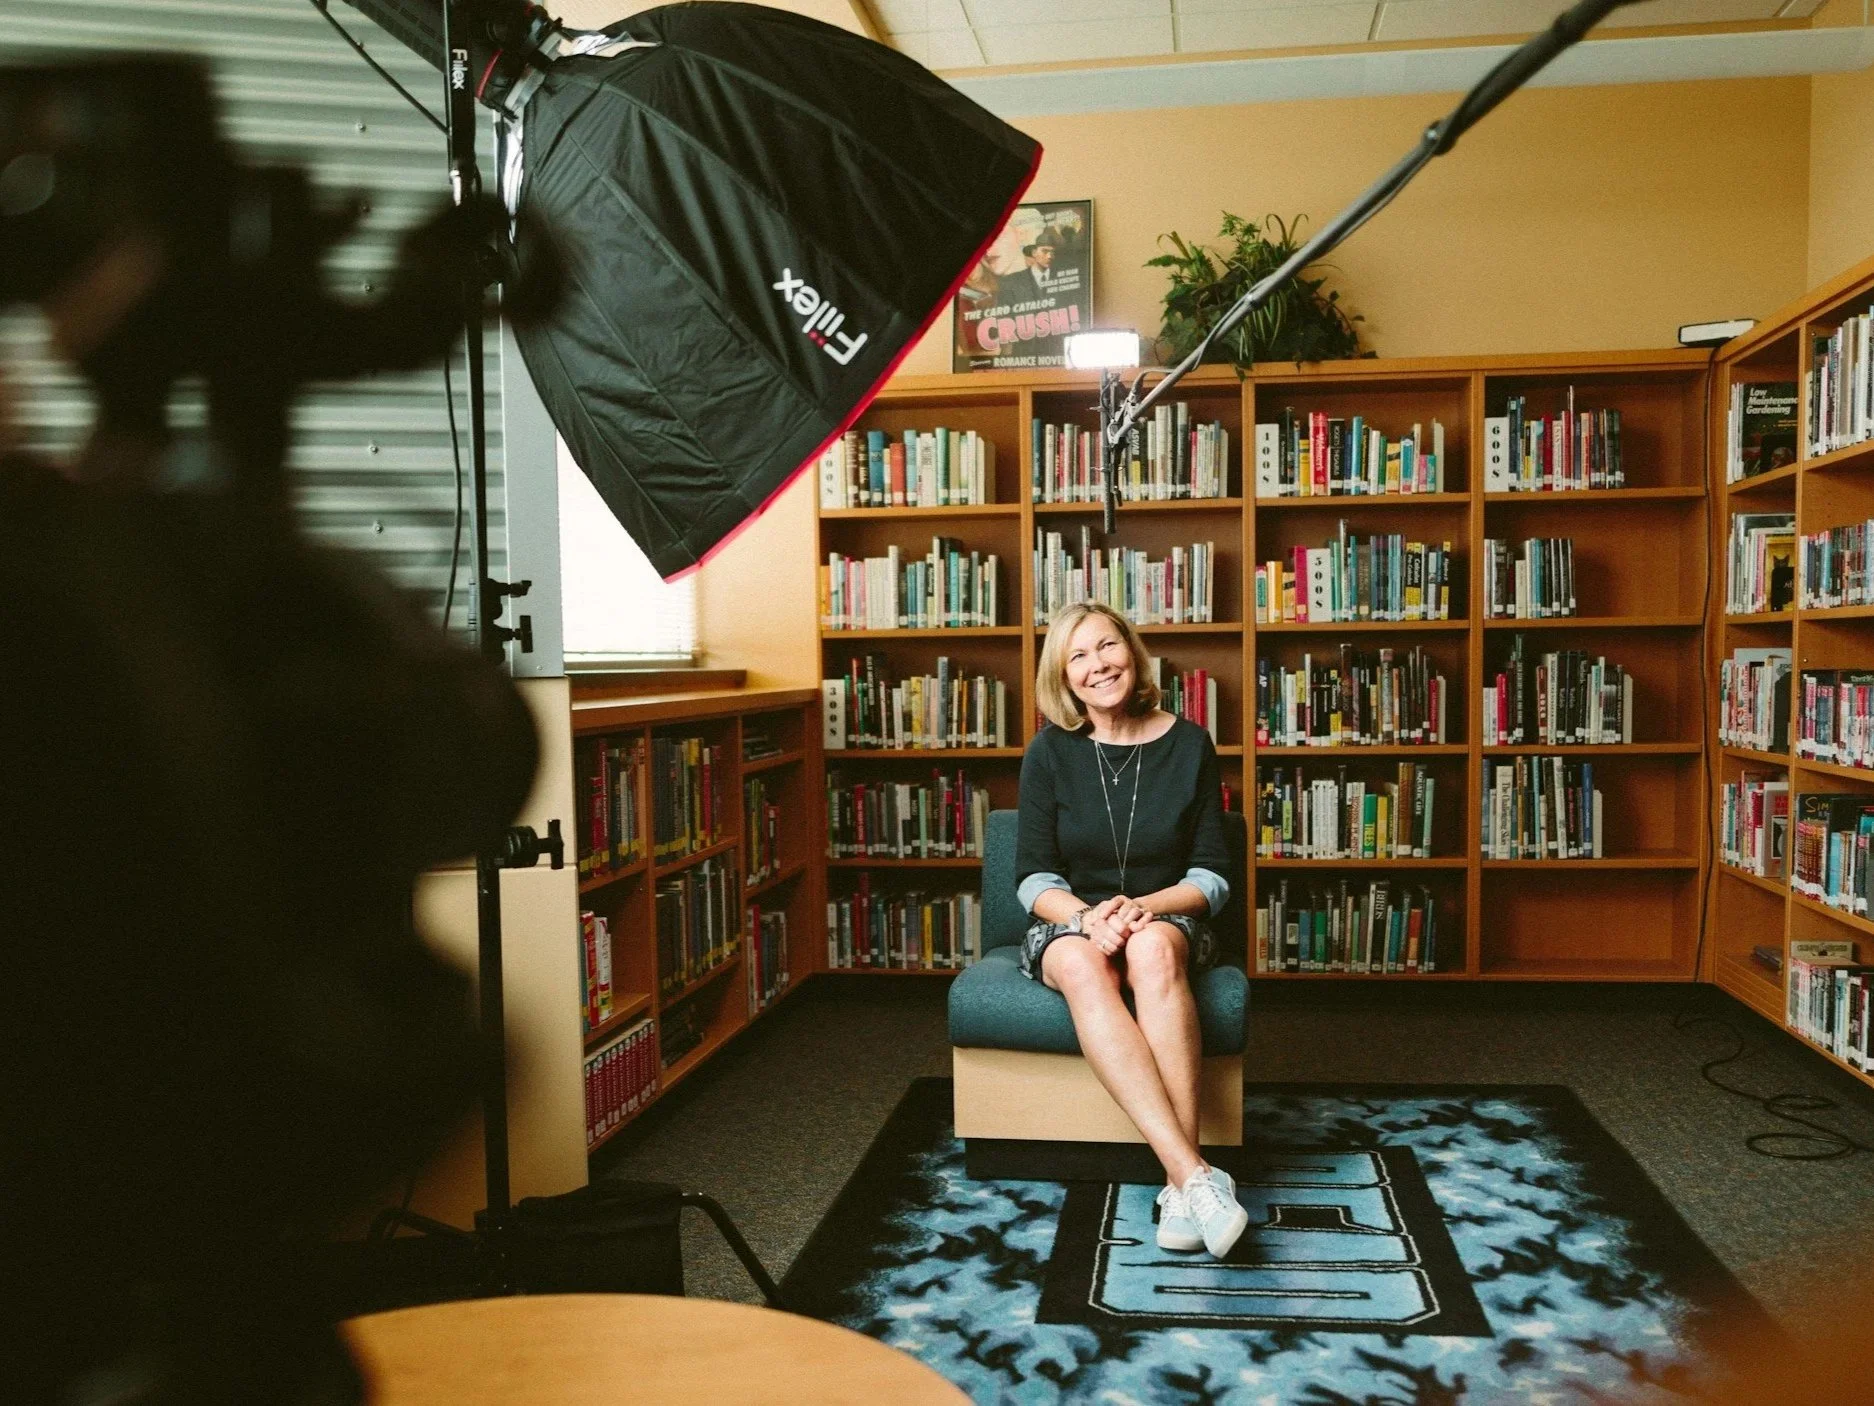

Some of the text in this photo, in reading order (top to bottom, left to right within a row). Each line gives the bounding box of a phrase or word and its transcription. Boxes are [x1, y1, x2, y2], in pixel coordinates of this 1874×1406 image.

[452, 48, 468, 90] Fiilex
[772, 267, 868, 365] Fiilex
[964, 298, 1056, 322] THE CARD CATALOG
[976, 304, 1081, 351] CRUSH!
[993, 356, 1037, 368] ROMANCE
[1748, 396, 1799, 405] Maintenanc
[1750, 387, 1768, 397] Low
[1746, 405, 1791, 415] Gardening
[1364, 822, 1375, 847] TREES
